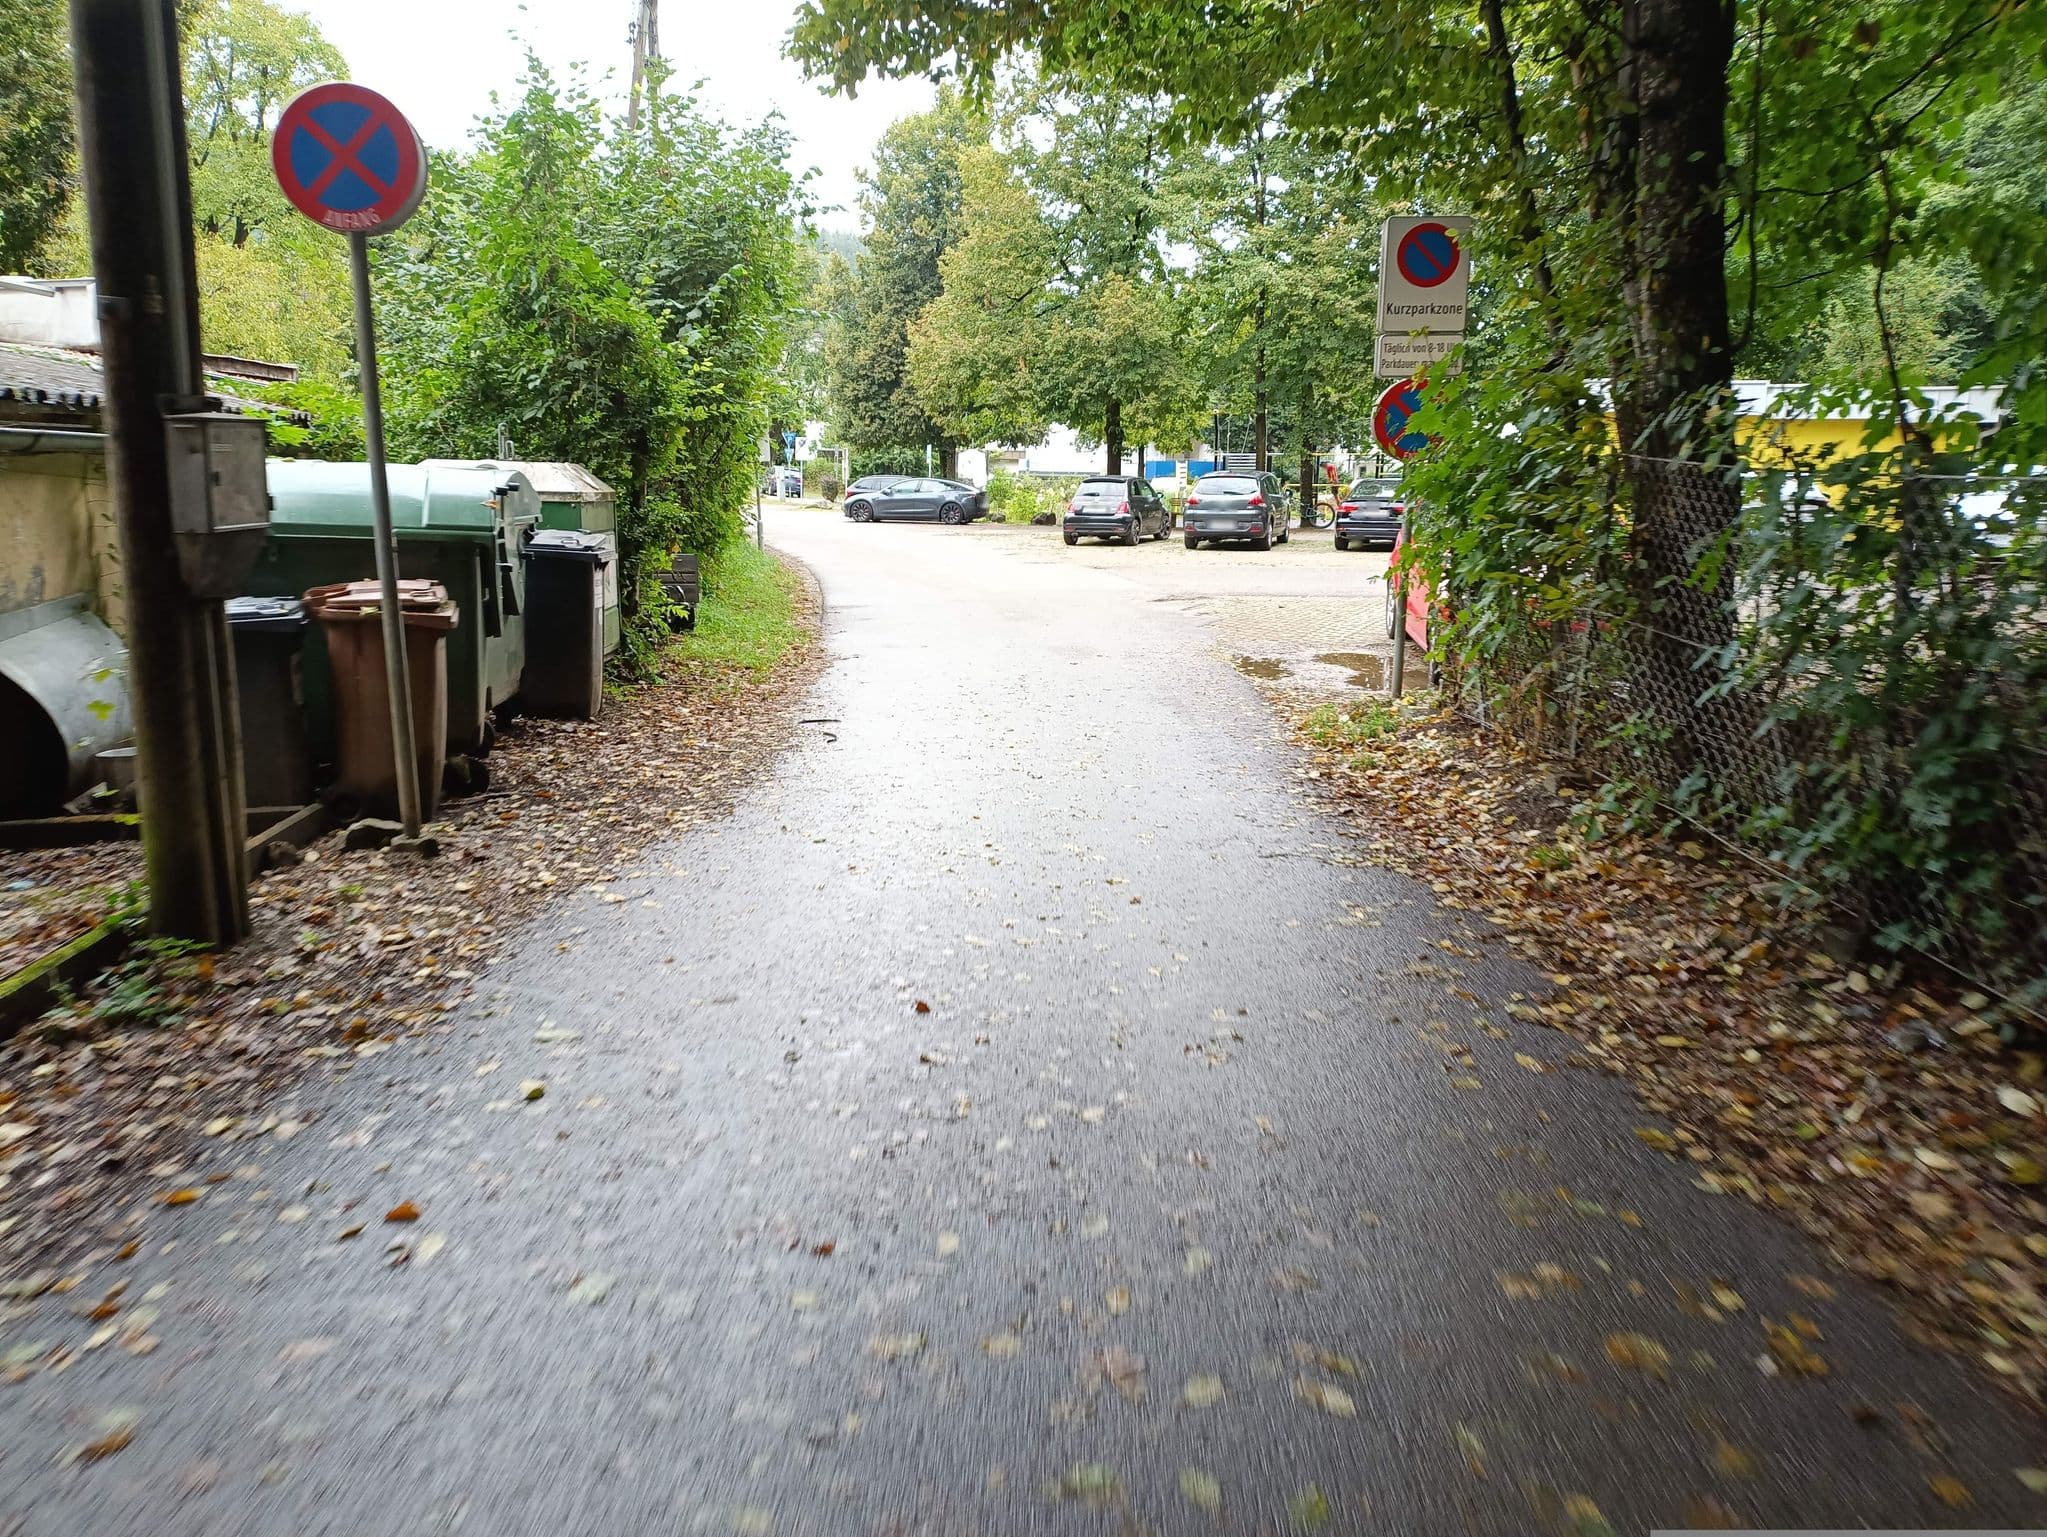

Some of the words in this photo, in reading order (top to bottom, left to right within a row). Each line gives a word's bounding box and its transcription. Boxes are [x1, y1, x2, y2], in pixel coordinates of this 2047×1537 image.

[1386, 302, 1463, 316] Kurzparkzone
[1384, 343, 1410, 355] Täglich
[1412, 344, 1427, 353] von
